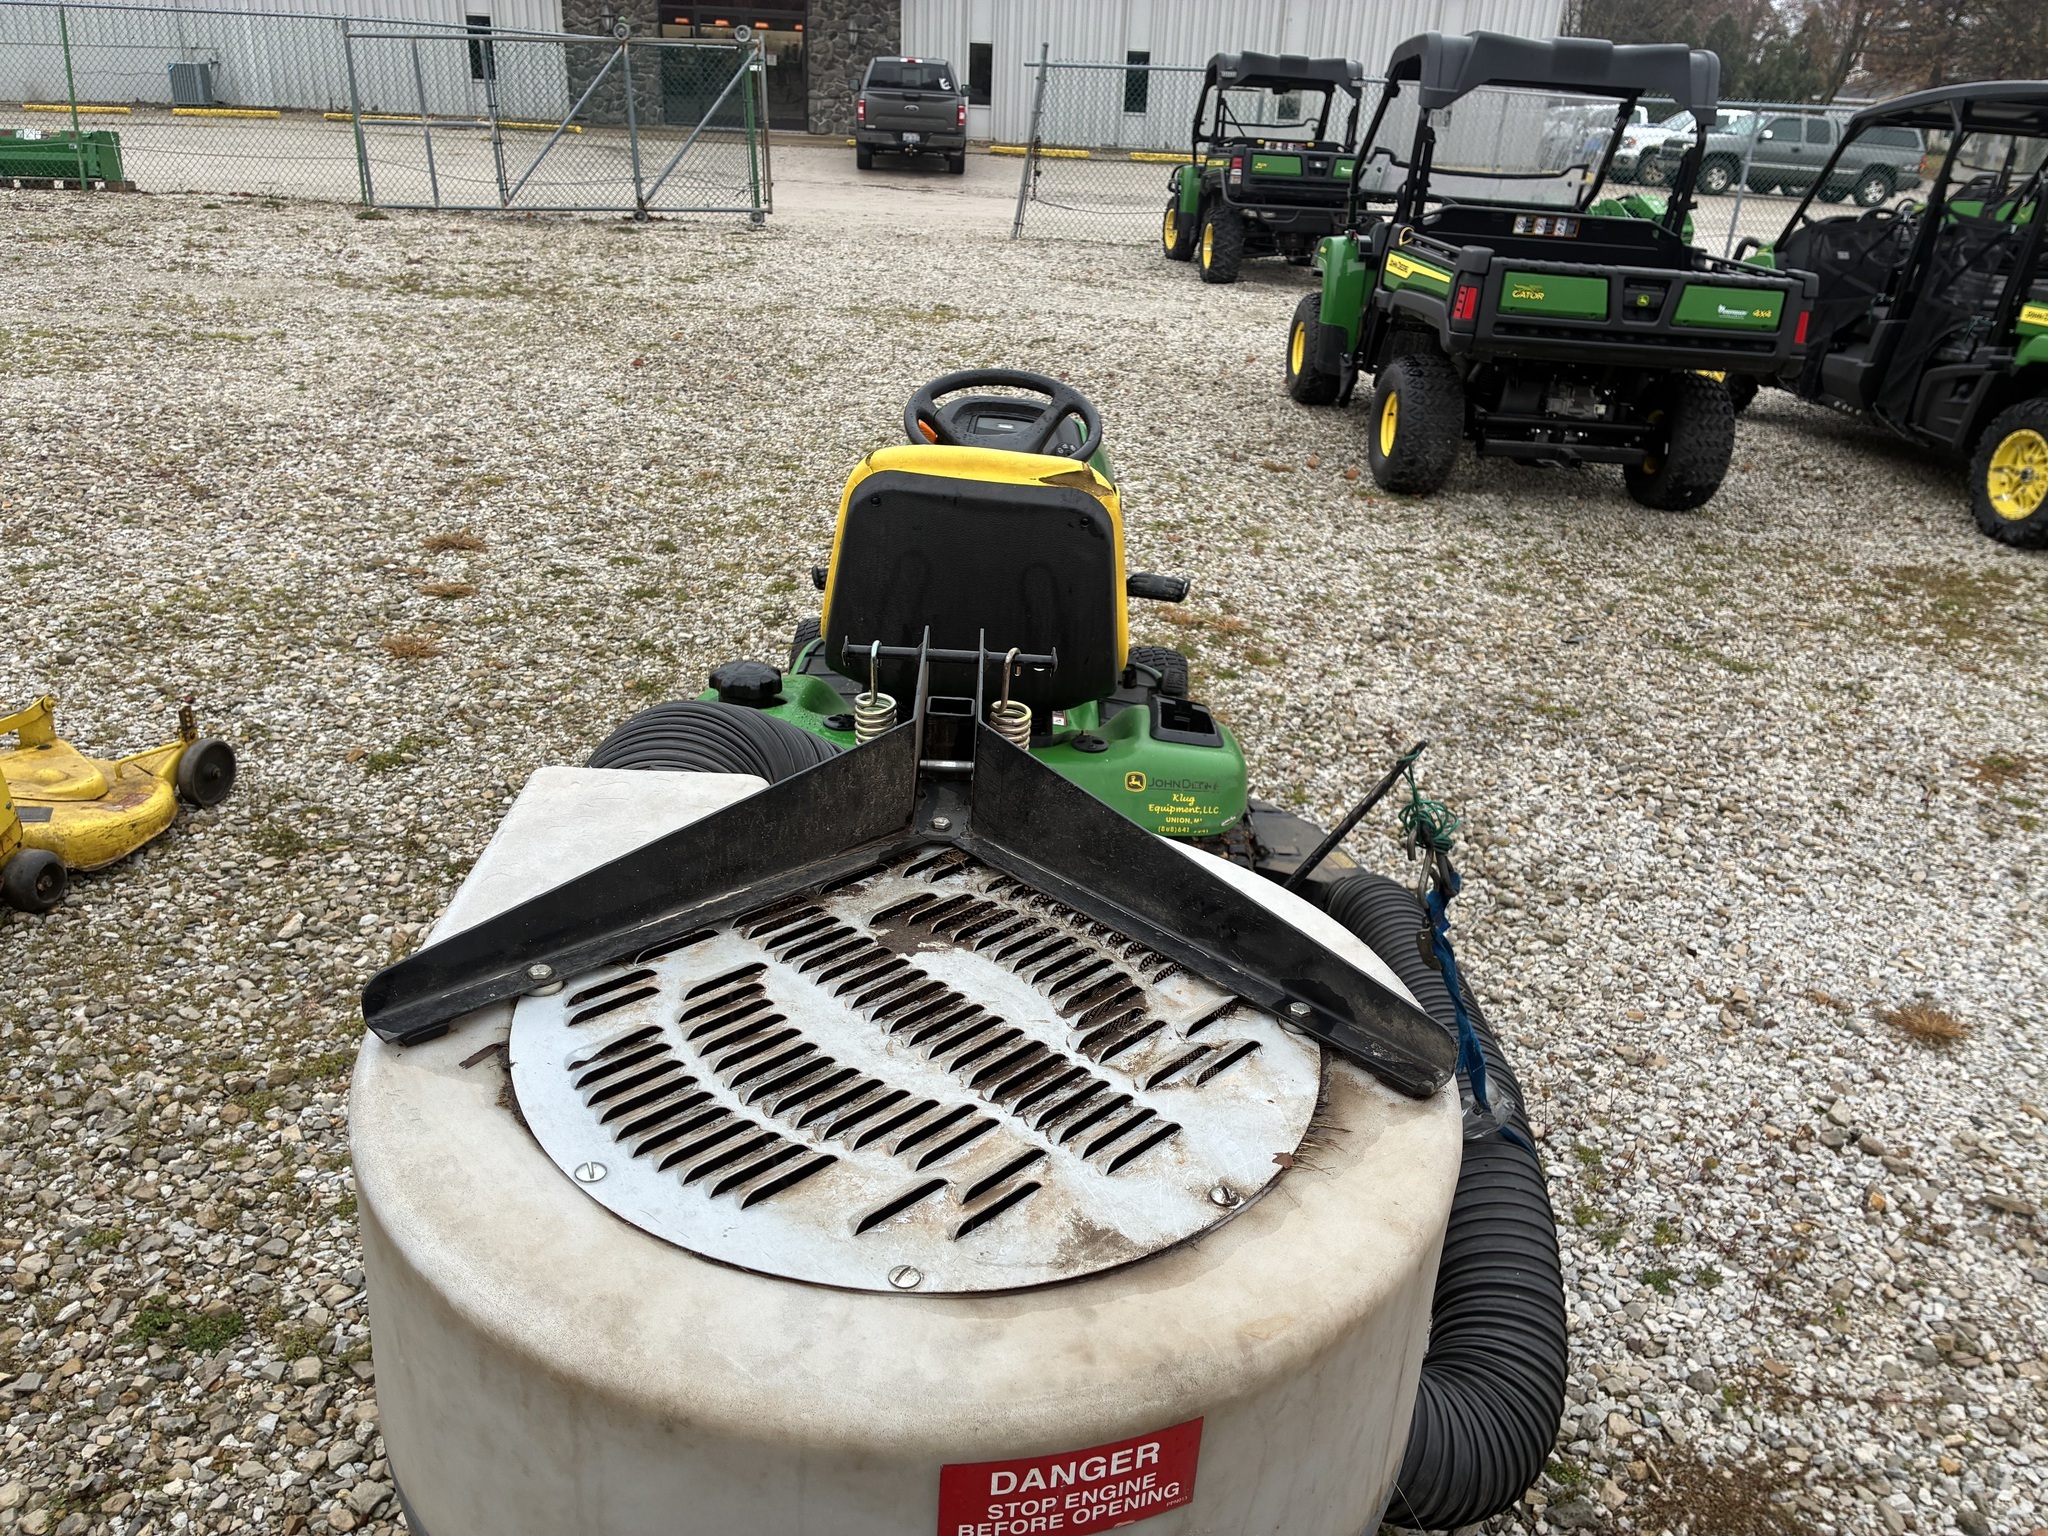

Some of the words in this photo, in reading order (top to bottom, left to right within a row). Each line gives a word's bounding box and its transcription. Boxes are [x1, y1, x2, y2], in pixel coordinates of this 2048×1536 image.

[1173, 794, 1195, 806] Klug
[990, 1441, 1161, 1496] DANGER
[957, 1513, 1065, 1536] BEFORE
[1072, 1481, 1181, 1525] OPENING
[987, 1497, 1058, 1520] STOP
[1064, 1472, 1157, 1509] ENGINE
